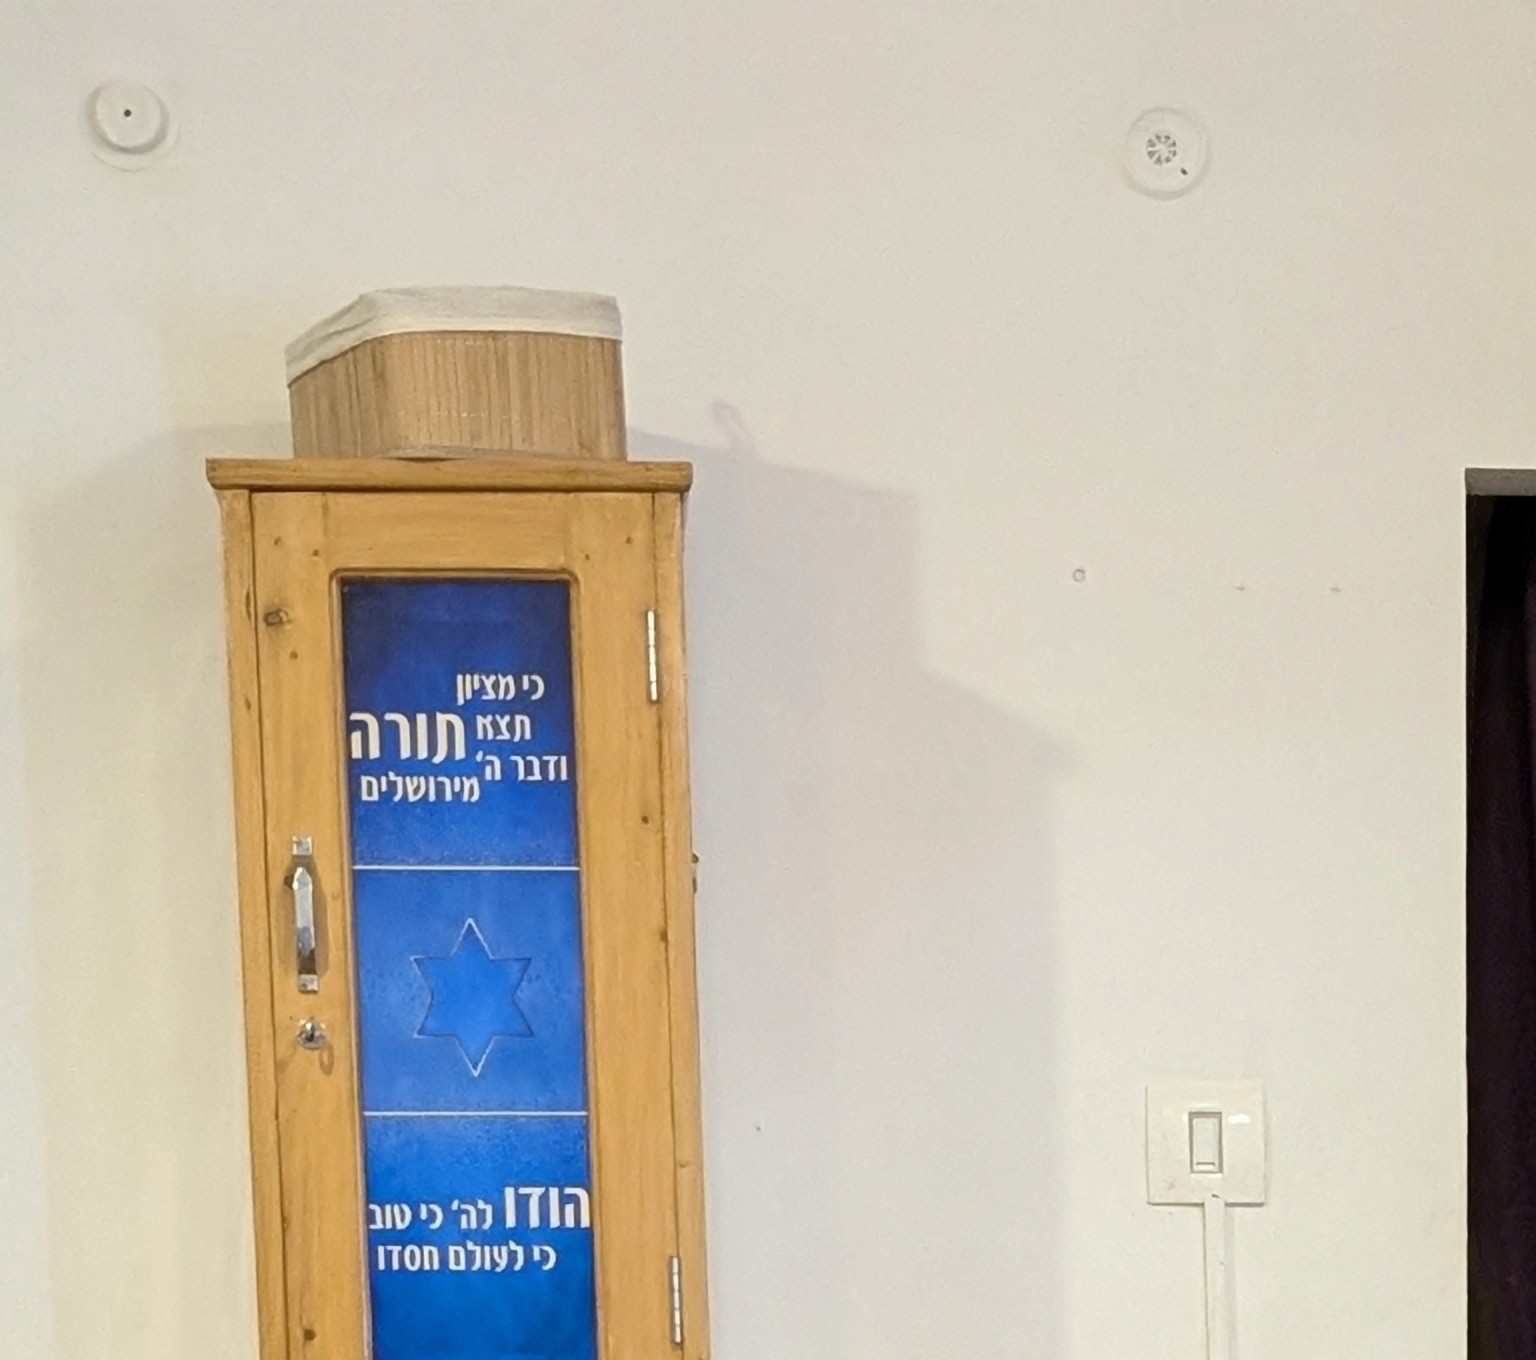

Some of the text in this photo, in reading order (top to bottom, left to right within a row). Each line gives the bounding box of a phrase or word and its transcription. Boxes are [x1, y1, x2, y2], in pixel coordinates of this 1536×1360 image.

[456, 673, 545, 706] כי מציון
[349, 711, 532, 764] תצא תורה
[510, 755, 568, 781] ודבר
[360, 772, 482, 803] מירושלים
[368, 1203, 412, 1230] טוב
[420, 1203, 444, 1230] כי
[504, 1186, 591, 1229] הודו
[377, 1241, 557, 1272] כי לעולם חסדו
